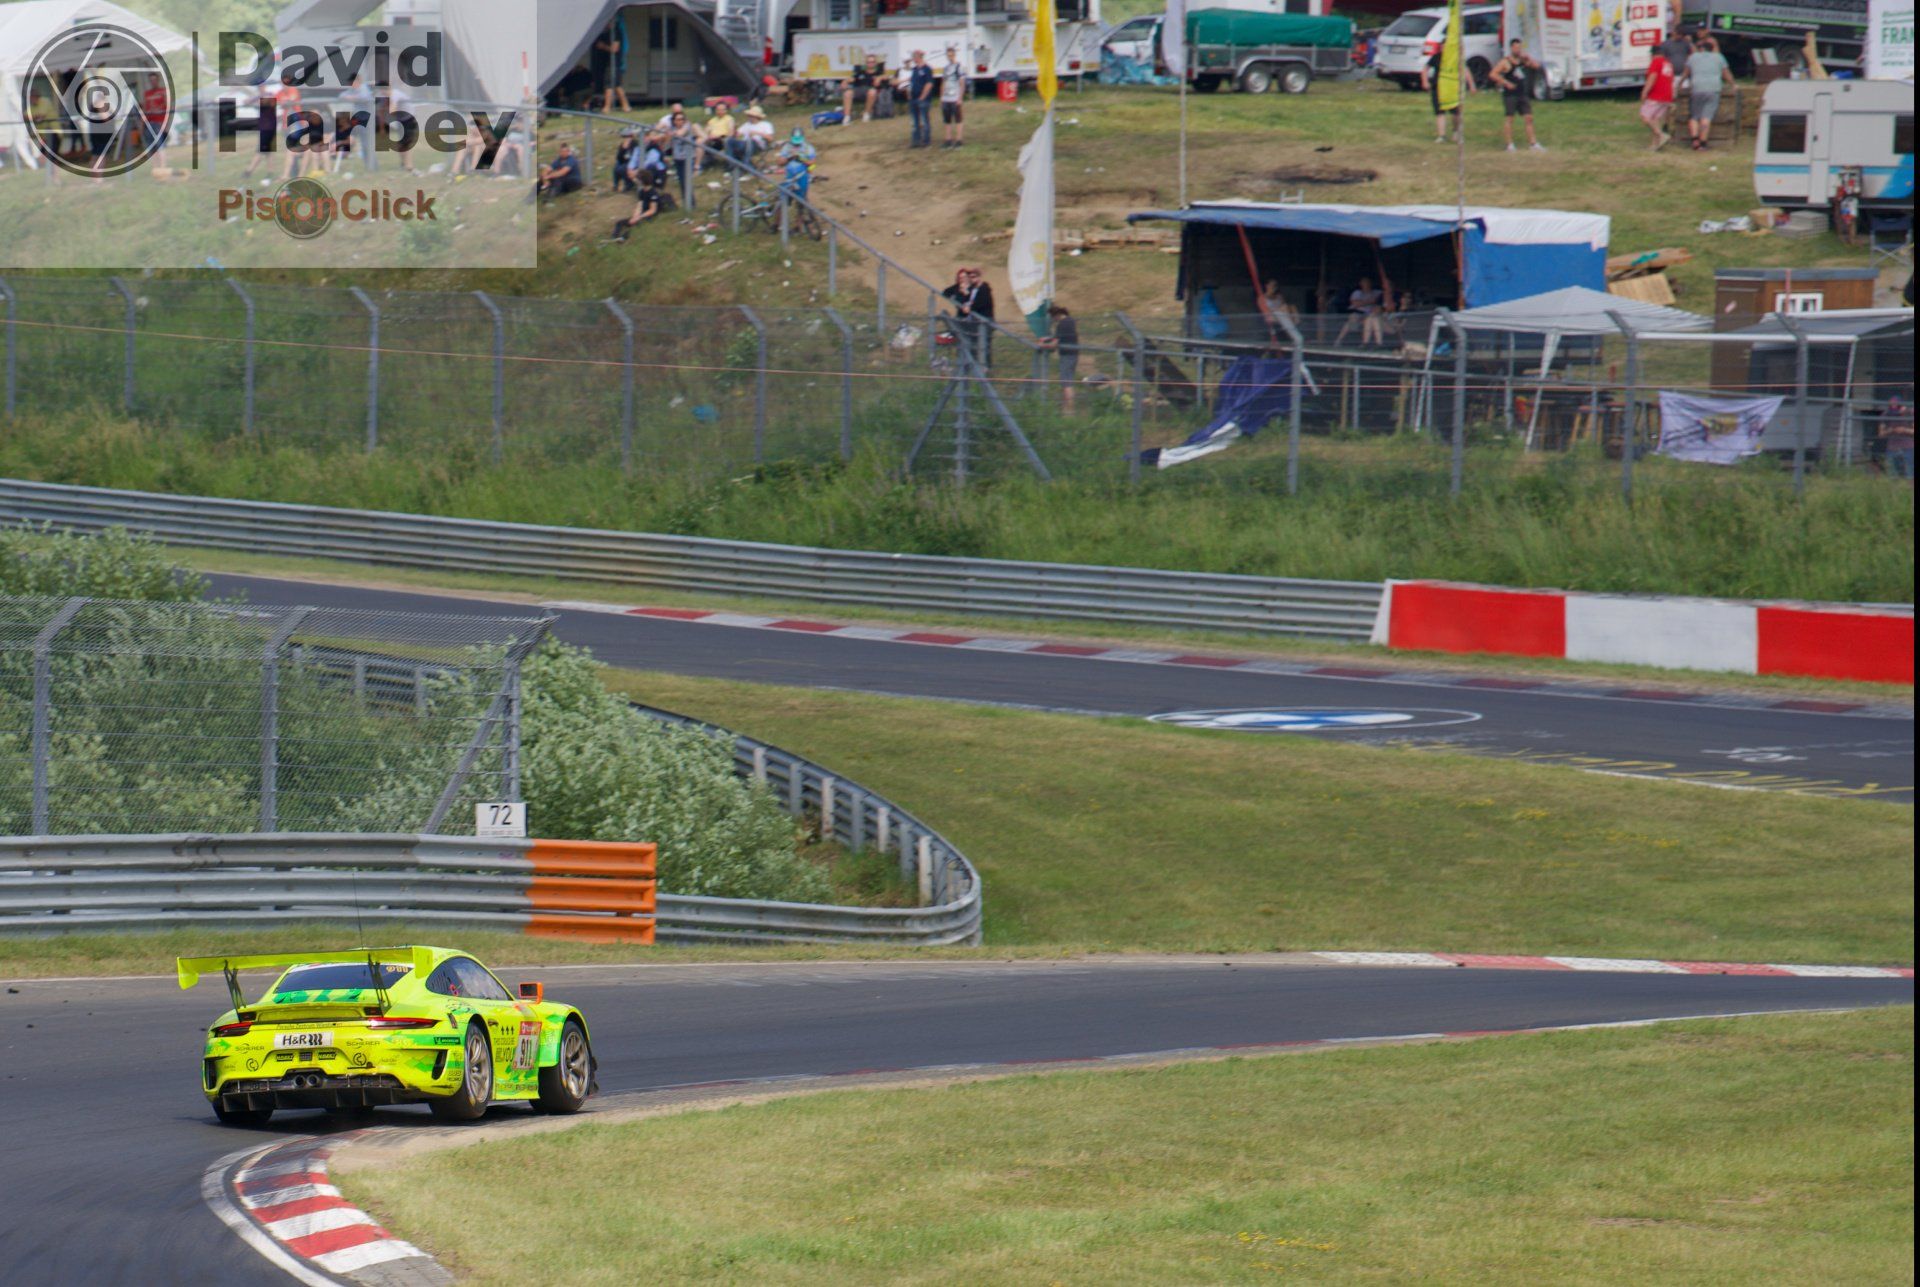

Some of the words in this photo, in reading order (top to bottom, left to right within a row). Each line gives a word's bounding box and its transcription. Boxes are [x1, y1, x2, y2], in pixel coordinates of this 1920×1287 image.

[489, 805, 512, 825] 72
[282, 1034, 307, 1046] H&R
[519, 1038, 532, 1067] 911
